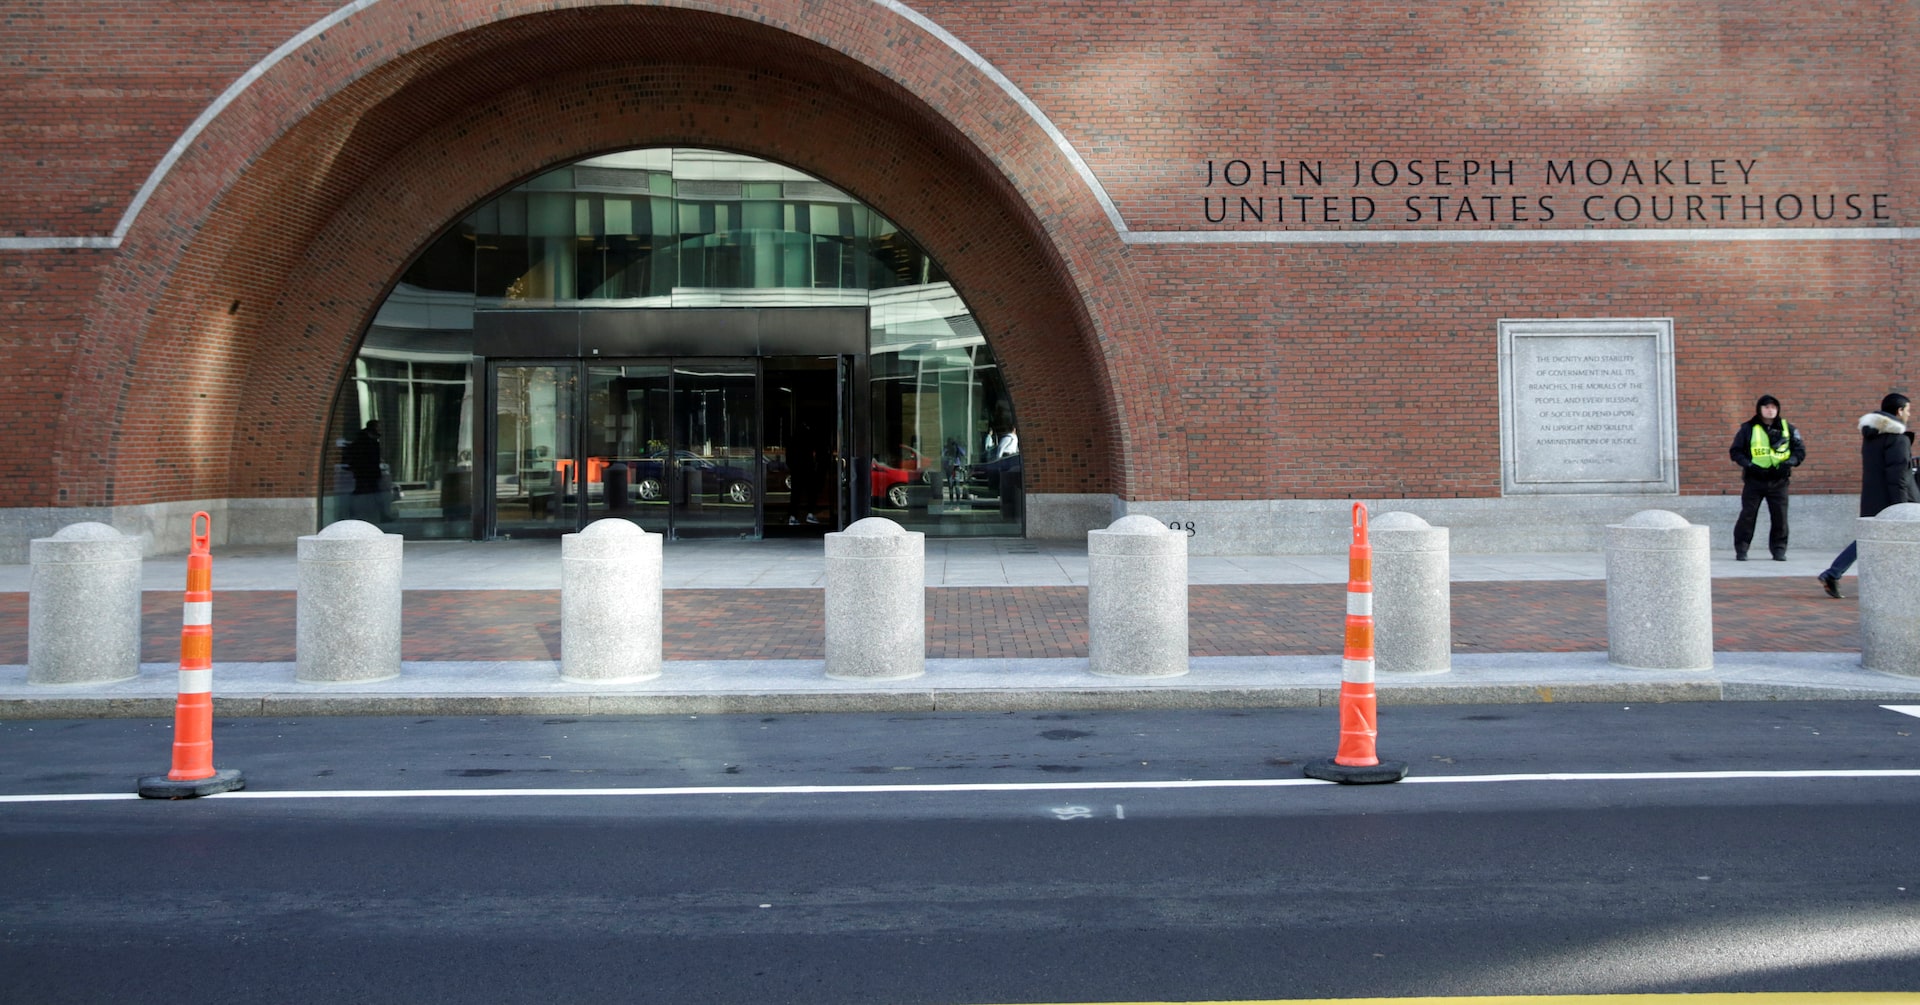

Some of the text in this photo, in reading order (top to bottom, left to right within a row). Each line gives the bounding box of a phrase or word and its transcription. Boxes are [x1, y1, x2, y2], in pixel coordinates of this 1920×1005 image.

[1204, 159, 1758, 187] JOHN JOSEPH MOAKLEY
[1204, 193, 1890, 223] UNITED STATES COURTHOUSE
